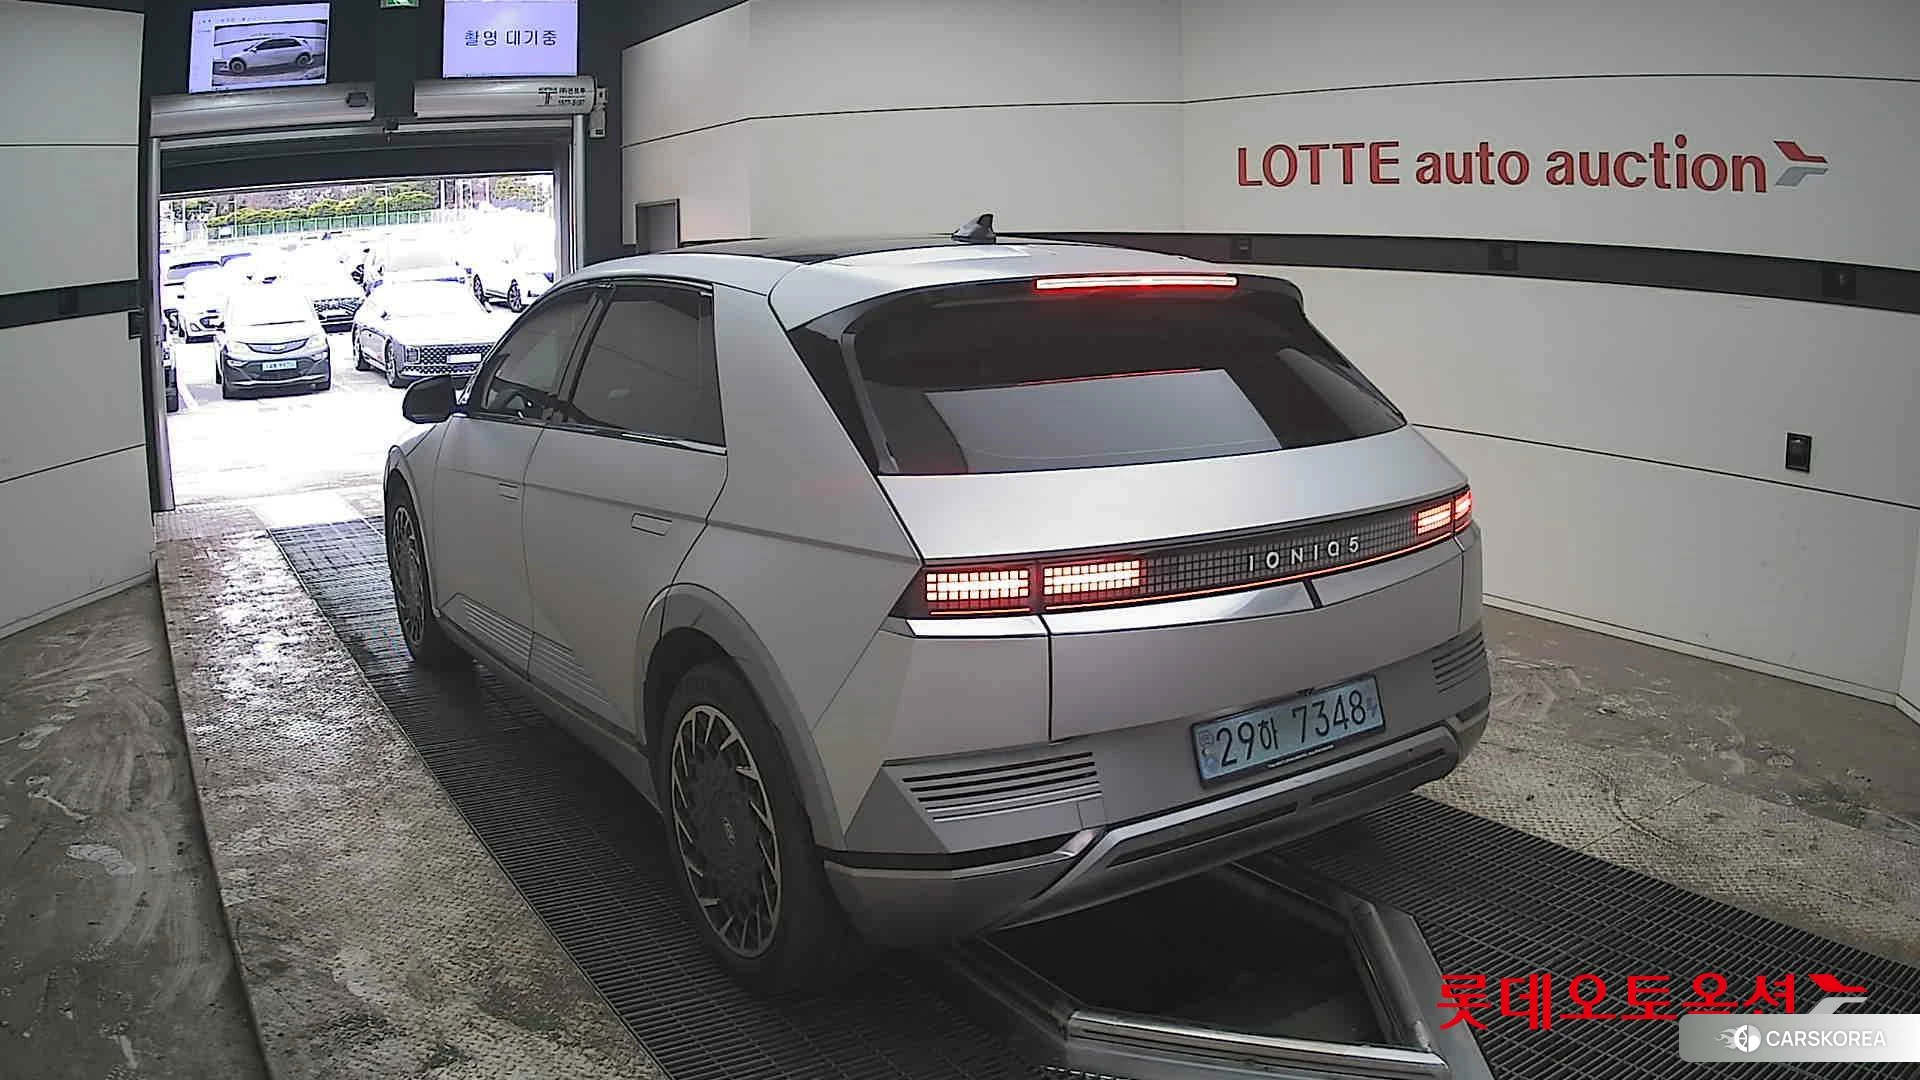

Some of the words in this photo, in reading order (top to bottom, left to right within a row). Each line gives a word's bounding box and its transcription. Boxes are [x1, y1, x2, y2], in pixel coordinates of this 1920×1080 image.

[464, 29, 498, 47] 촬영
[505, 29, 558, 47] 대기중
[1237, 140, 1400, 188] LOTTE
[1415, 141, 1529, 187] auto
[1546, 134, 1768, 194] auction
[1216, 717, 1280, 768] 29하
[1291, 690, 1367, 744] 7348
